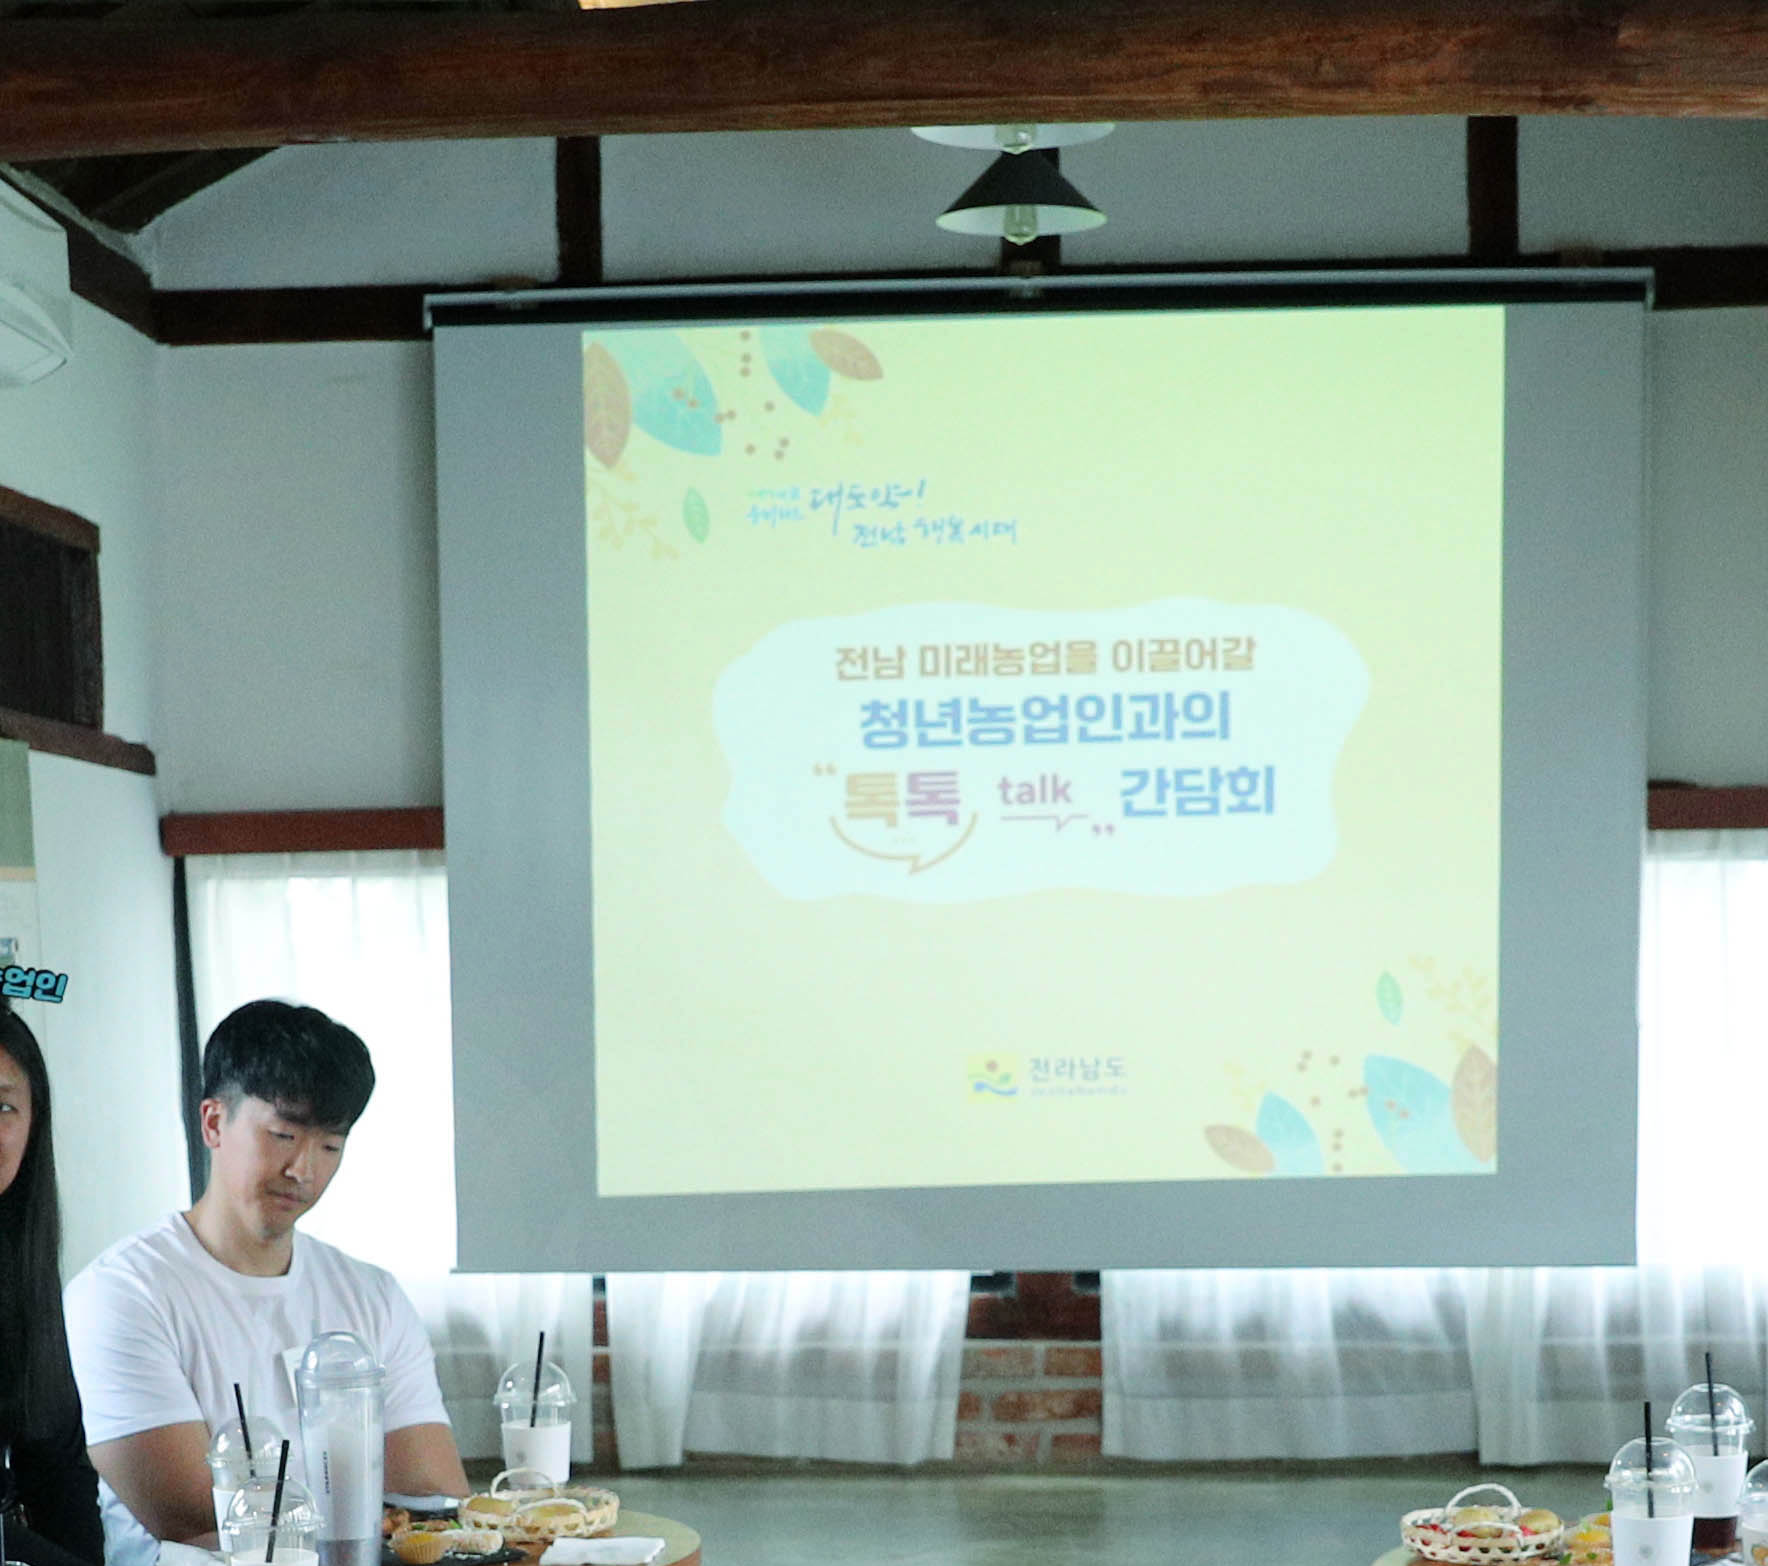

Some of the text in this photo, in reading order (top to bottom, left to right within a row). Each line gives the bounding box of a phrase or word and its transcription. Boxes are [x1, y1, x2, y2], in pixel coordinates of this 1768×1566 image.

[834, 636, 1257, 681] 전남 미래농업을 이끌어갈
[859, 690, 1231, 750] 청년농업인과의
[1119, 765, 1277, 818] 간담회
[1029, 1056, 1126, 1083] 전라남도
